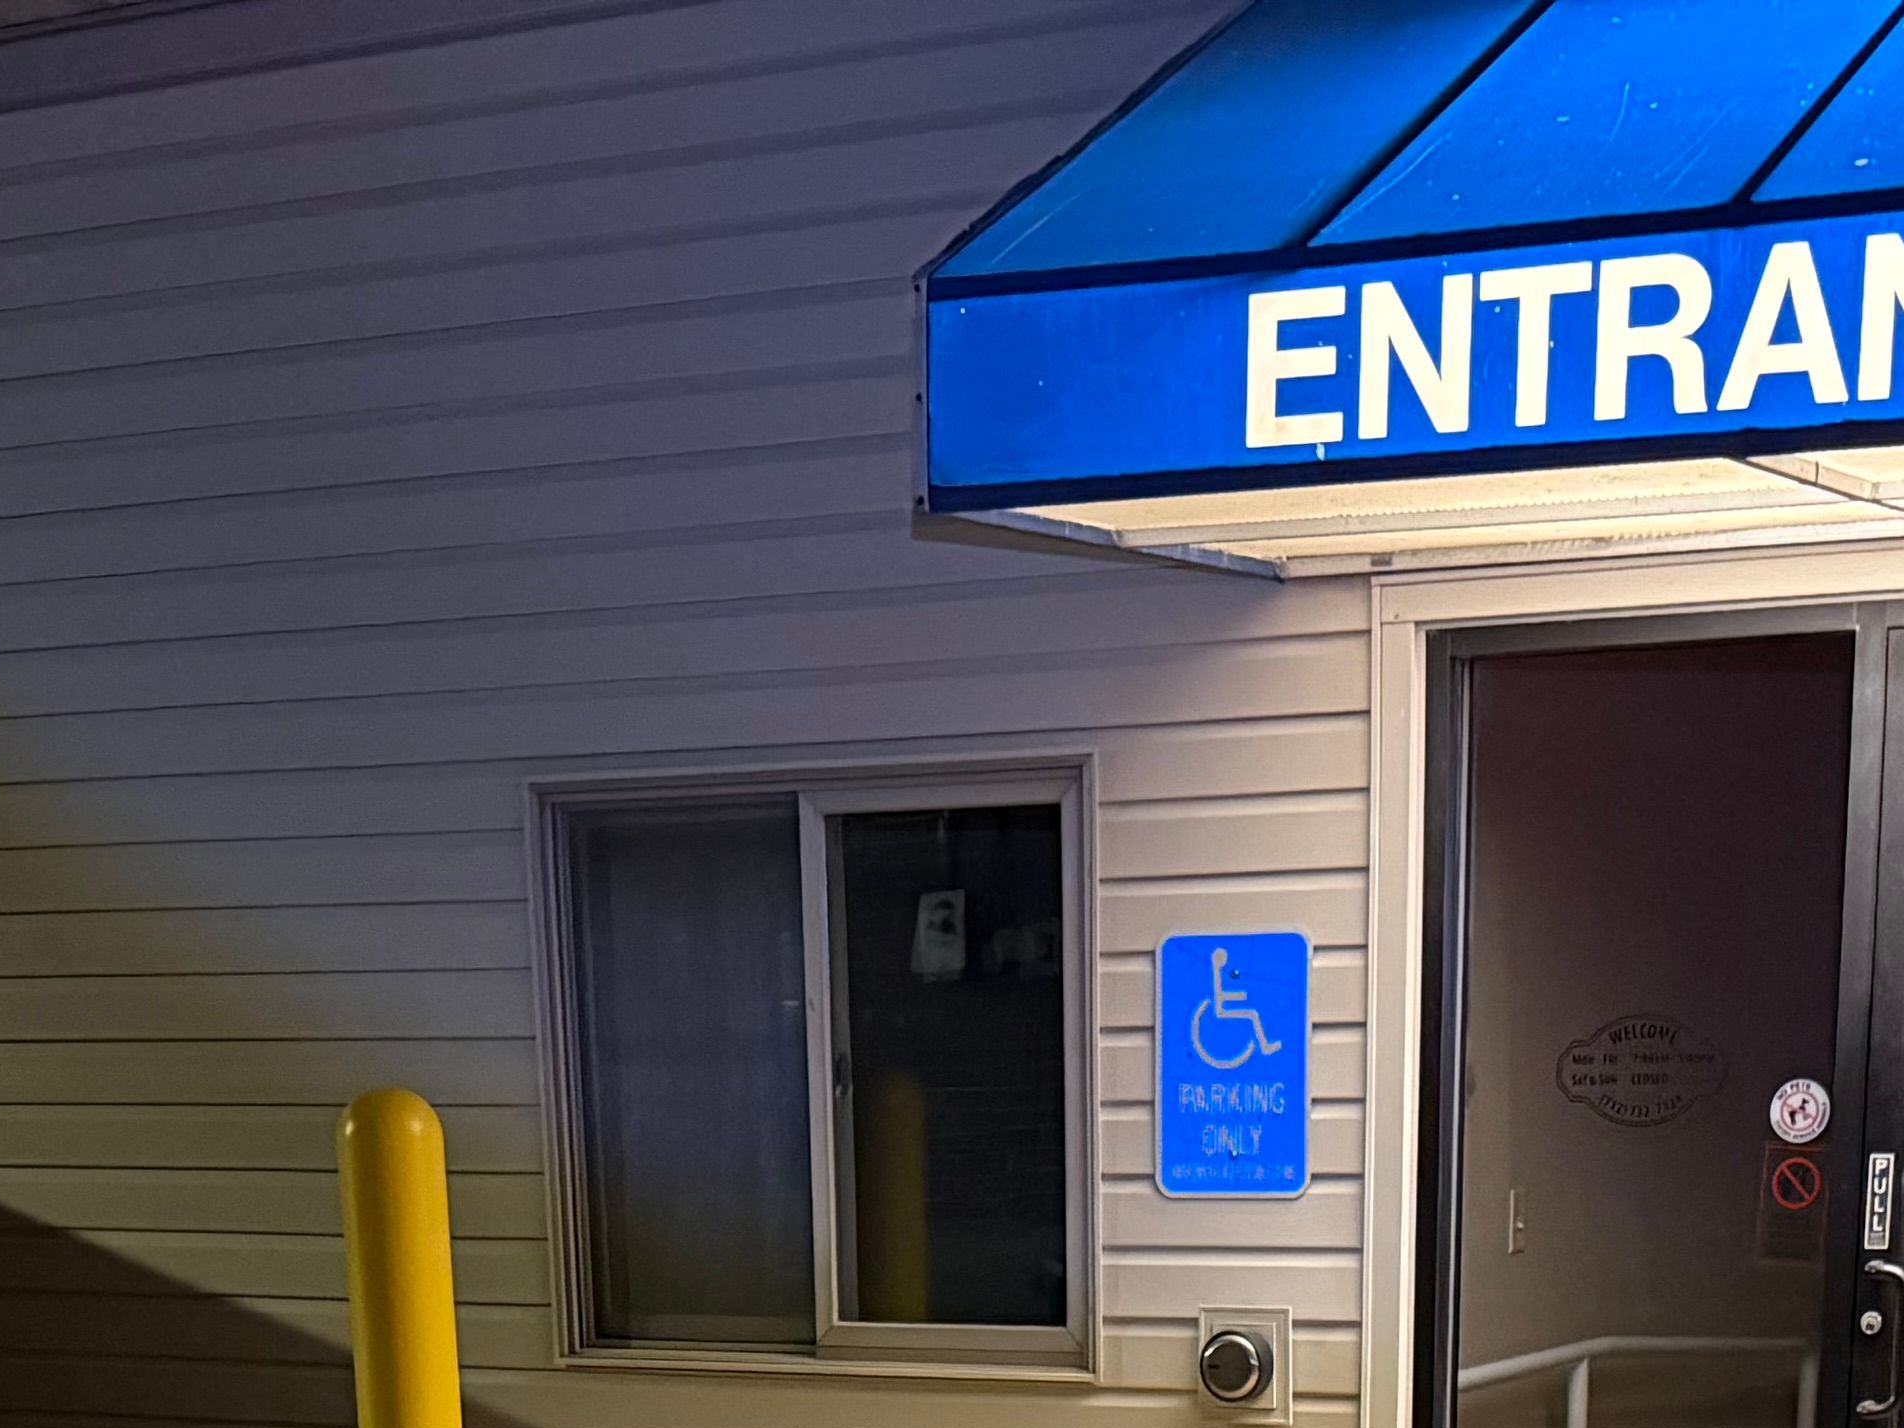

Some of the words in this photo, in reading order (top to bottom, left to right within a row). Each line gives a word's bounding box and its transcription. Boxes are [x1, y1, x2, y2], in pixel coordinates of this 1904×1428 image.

[1608, 1022, 1678, 1046] WELCOME
[1178, 1082, 1286, 1115] PARKING
[1202, 1124, 1263, 1155] ONLY
[1872, 1158, 1888, 1232] PULL
